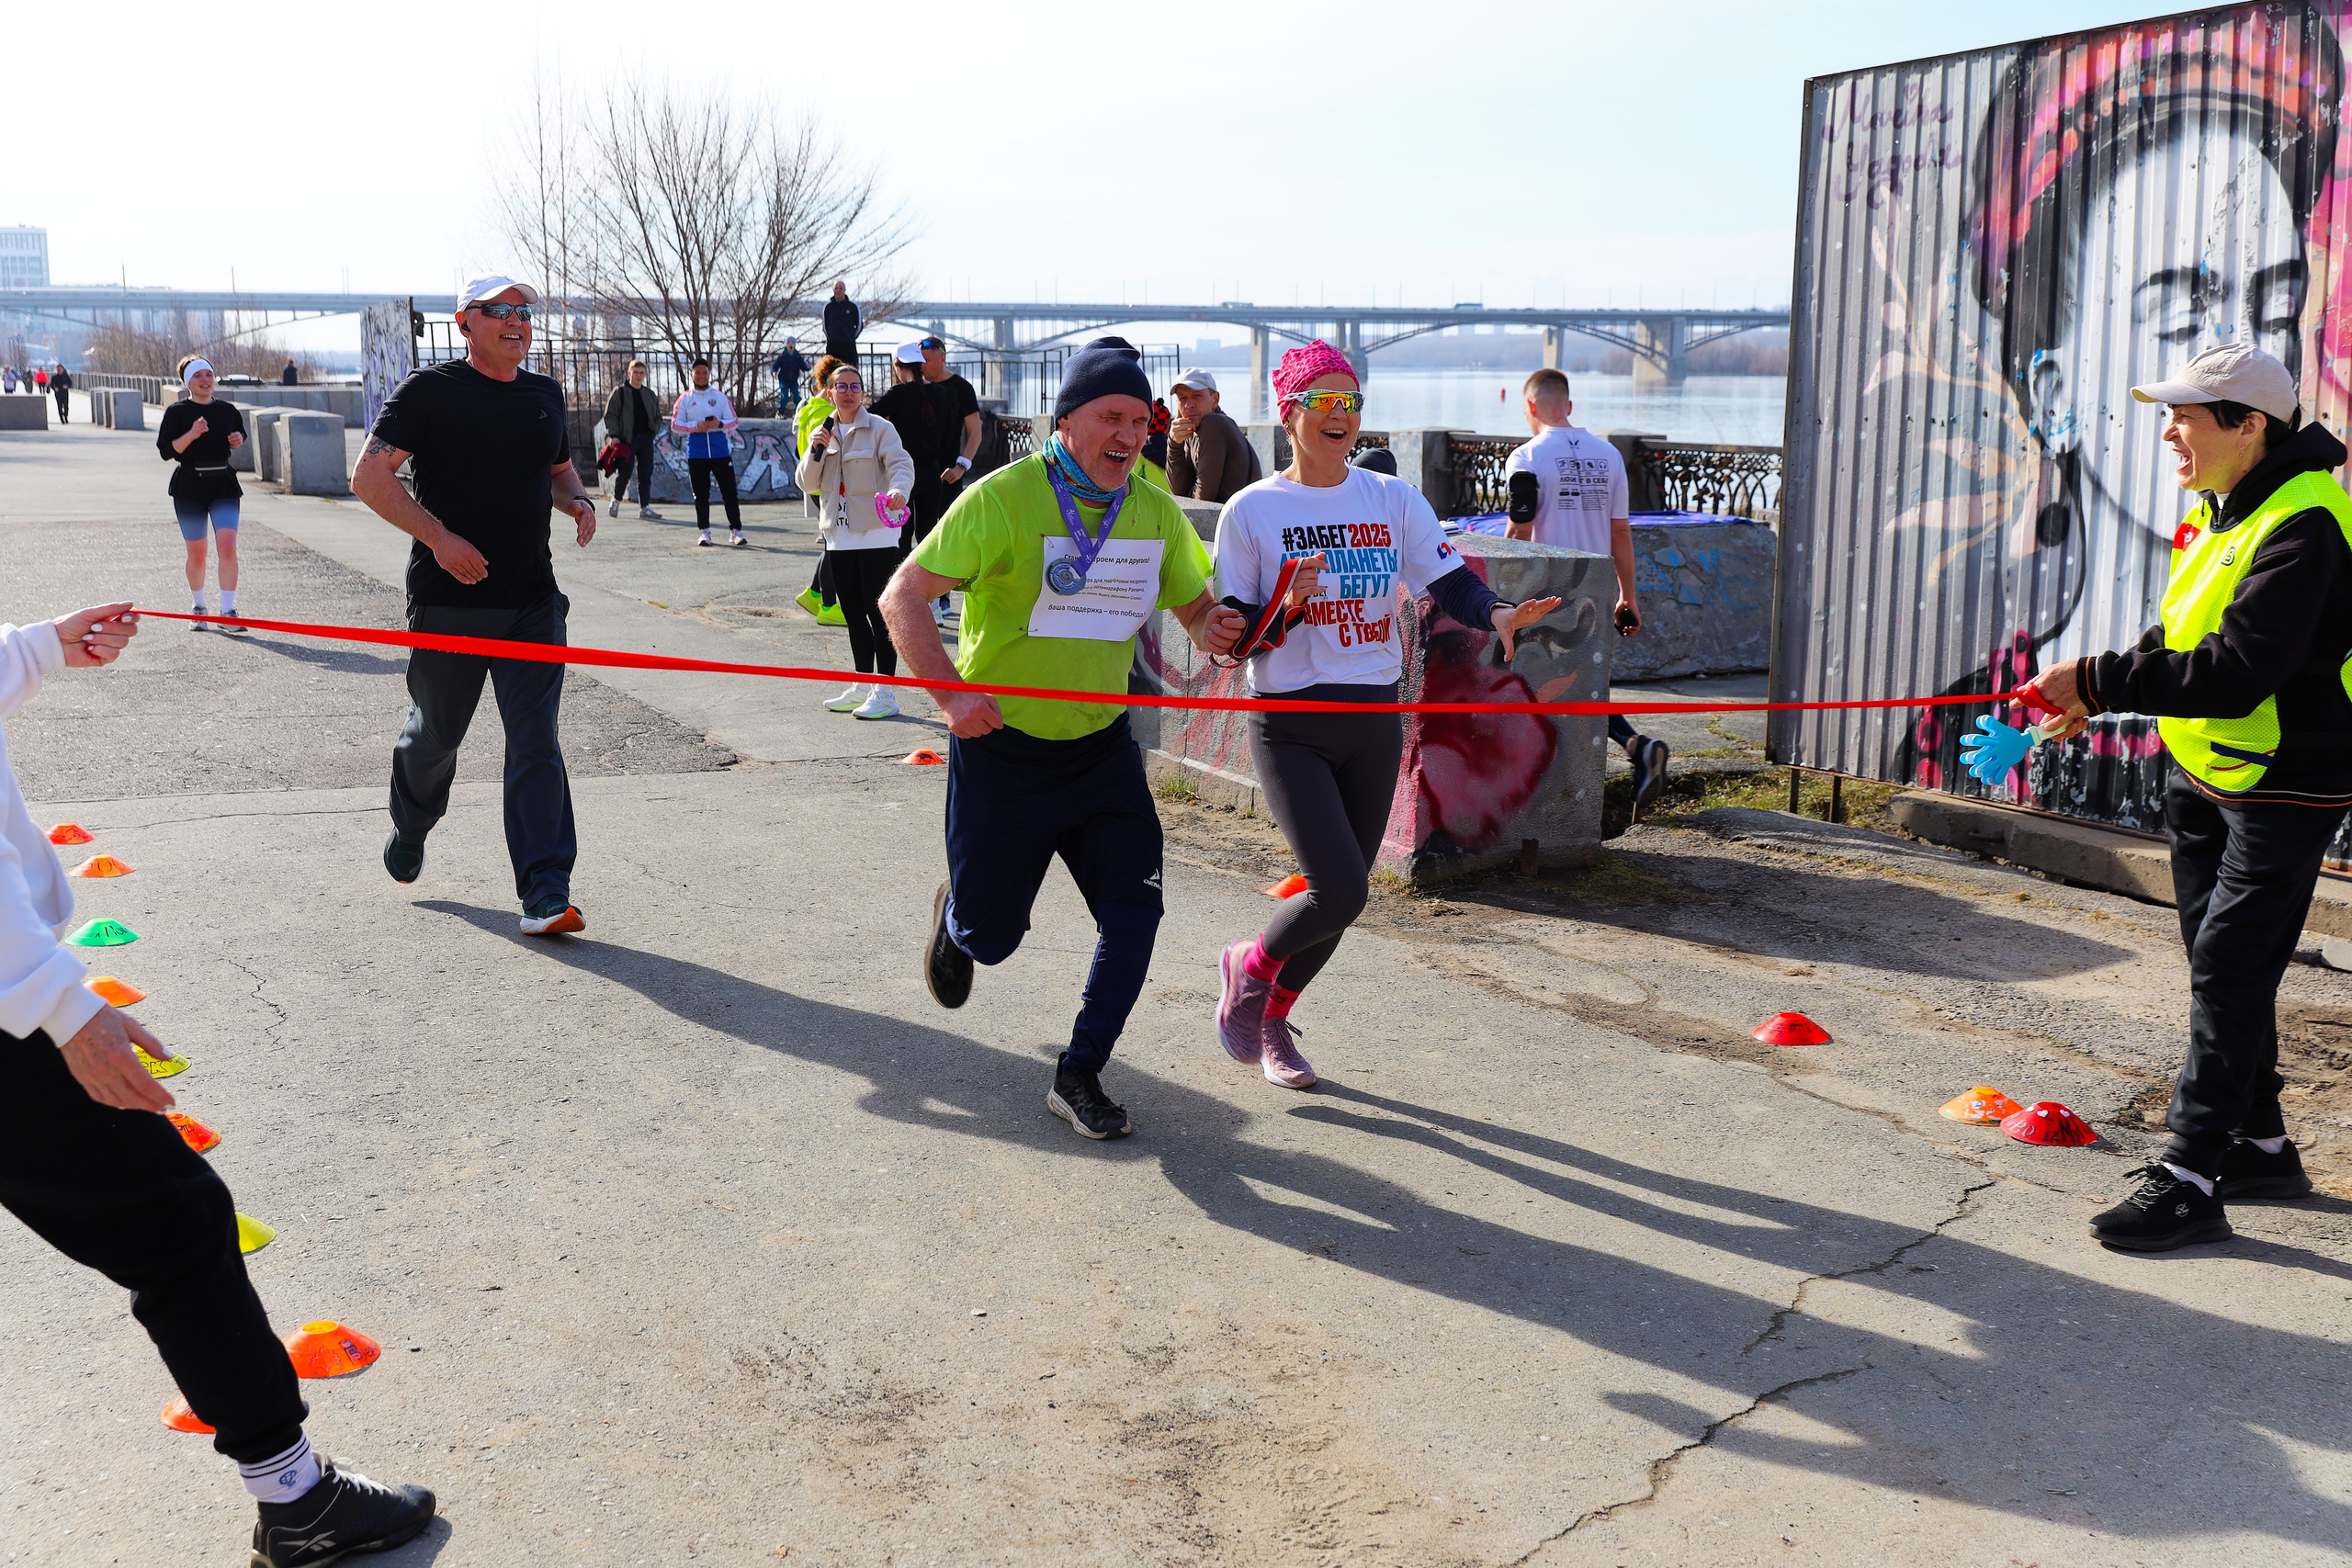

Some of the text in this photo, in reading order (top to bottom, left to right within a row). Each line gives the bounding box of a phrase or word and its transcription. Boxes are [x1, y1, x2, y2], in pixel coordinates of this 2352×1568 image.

[1340, 573, 1391, 600] БЕГУТ
[1067, 605, 1102, 615] поддержка
[1120, 609, 1147, 618] победа!
[1303, 599, 1365, 626] ВМЕСТЕ
[1339, 614, 1391, 648] С ТОБОЙ
